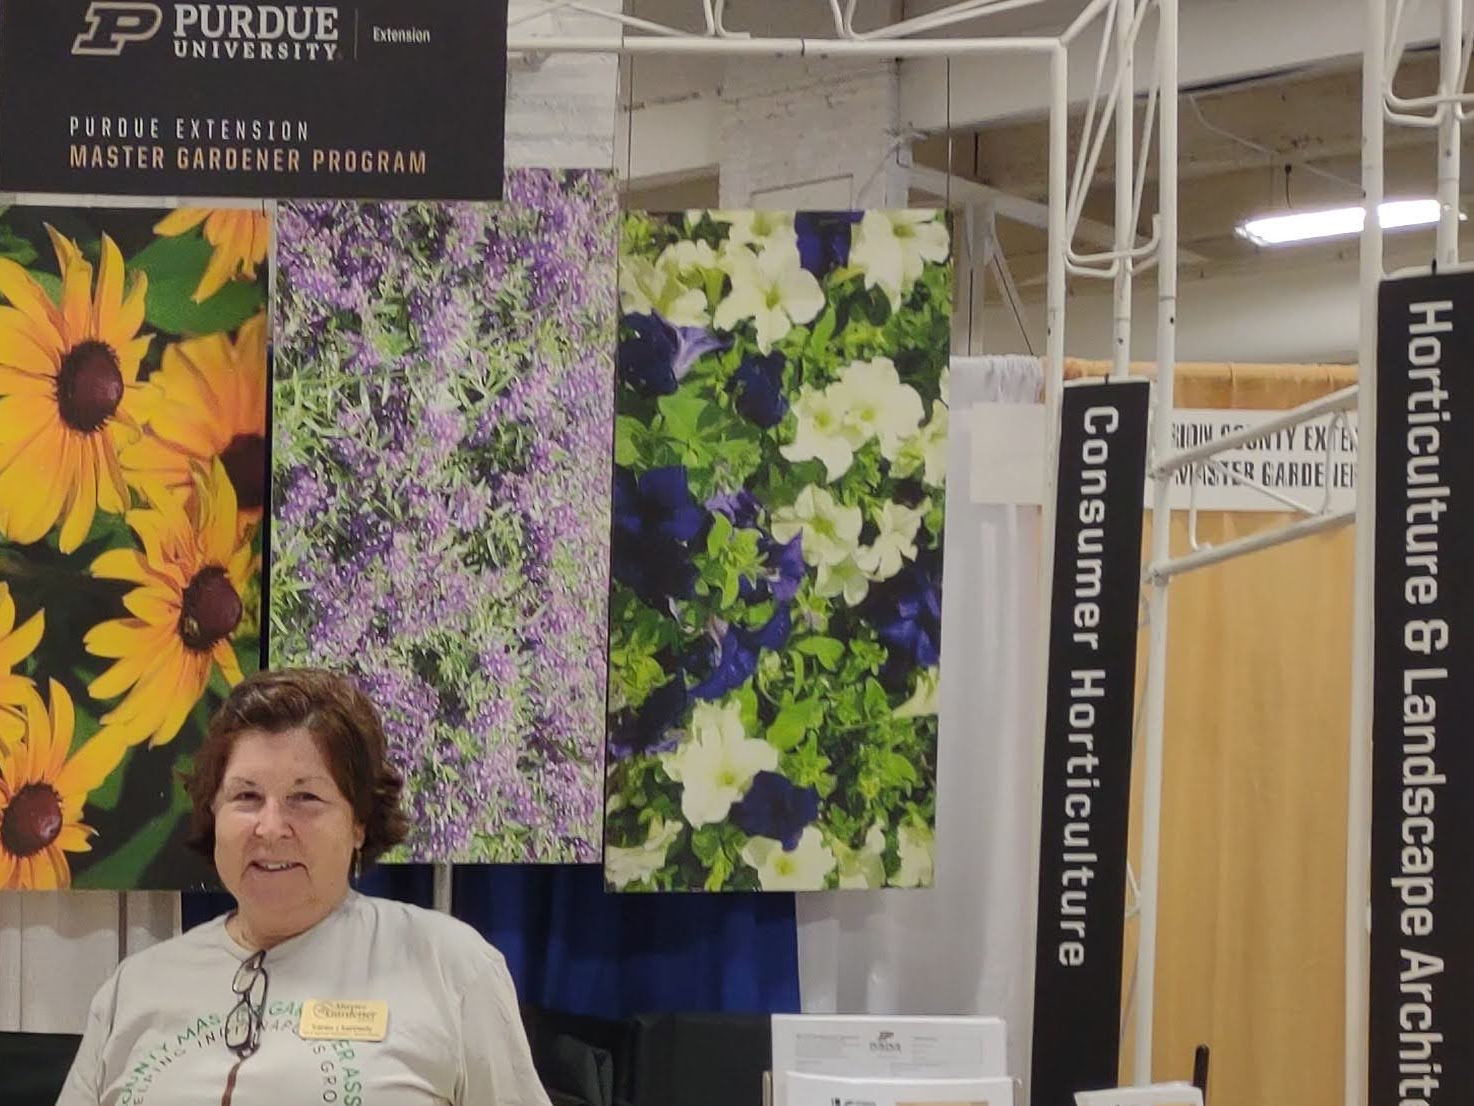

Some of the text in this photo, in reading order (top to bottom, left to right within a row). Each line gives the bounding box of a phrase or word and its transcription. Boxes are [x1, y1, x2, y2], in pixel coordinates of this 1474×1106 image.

[173, 4, 339, 41] PURDUE
[373, 26, 431, 44] Extension
[173, 40, 338, 60] UNIVERSITY
[69, 116, 310, 141] PURDUE EXTENSION
[69, 145, 427, 174] MASTER GARDENER PROGRAM
[1404, 300, 1453, 604] Horticulture
[1403, 619, 1449, 654] &
[1058, 405, 1119, 967] Consumer Horticulture
[1399, 668, 1448, 936] Landscape
